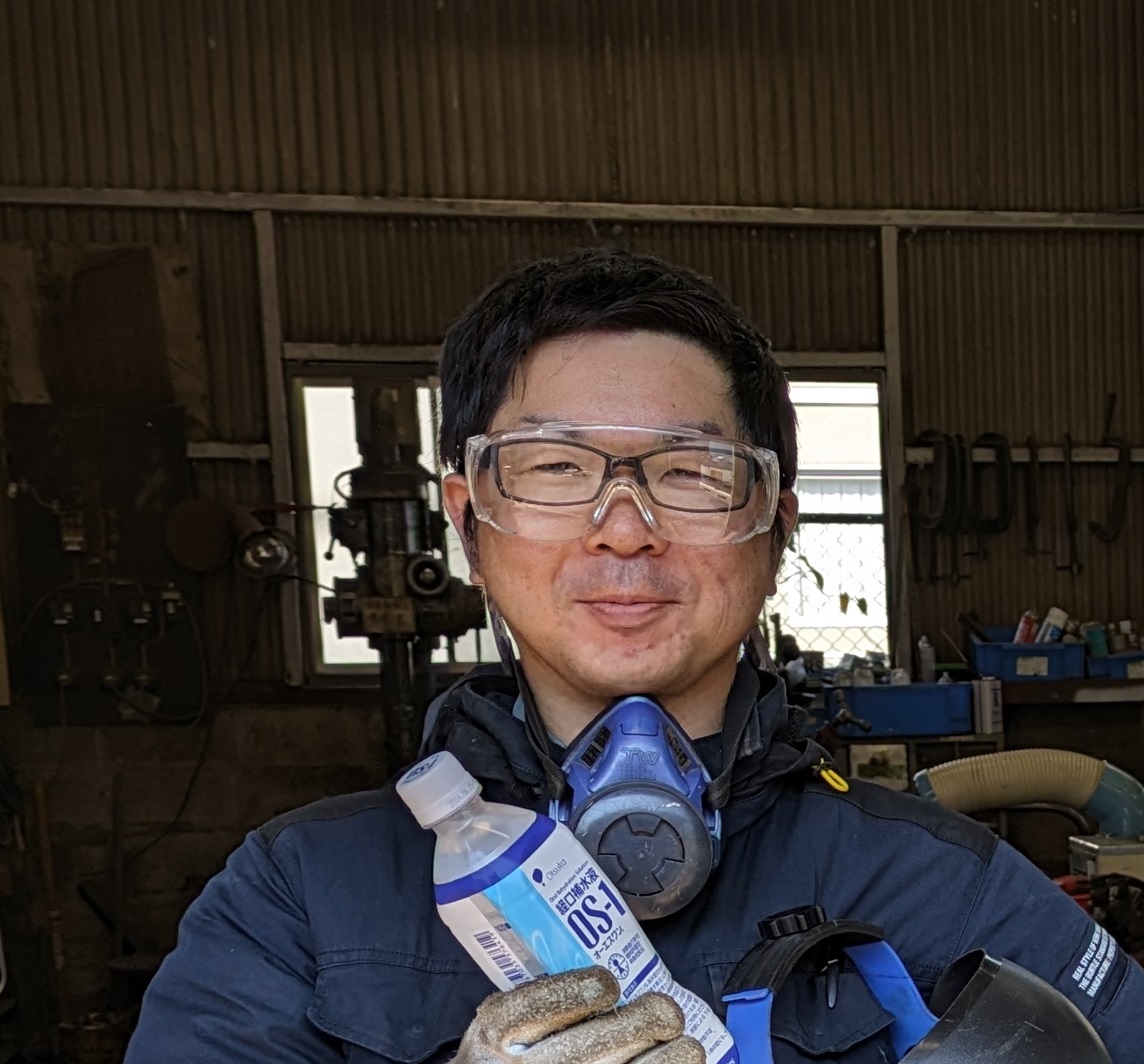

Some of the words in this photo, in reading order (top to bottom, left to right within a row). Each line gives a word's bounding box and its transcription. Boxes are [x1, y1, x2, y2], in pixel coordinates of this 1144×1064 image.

[546, 858, 567, 881] Otsuka
[555, 866, 600, 916] 経口補水液
[567, 880, 627, 950] OS-1
[594, 925, 624, 960] オーエスワン
